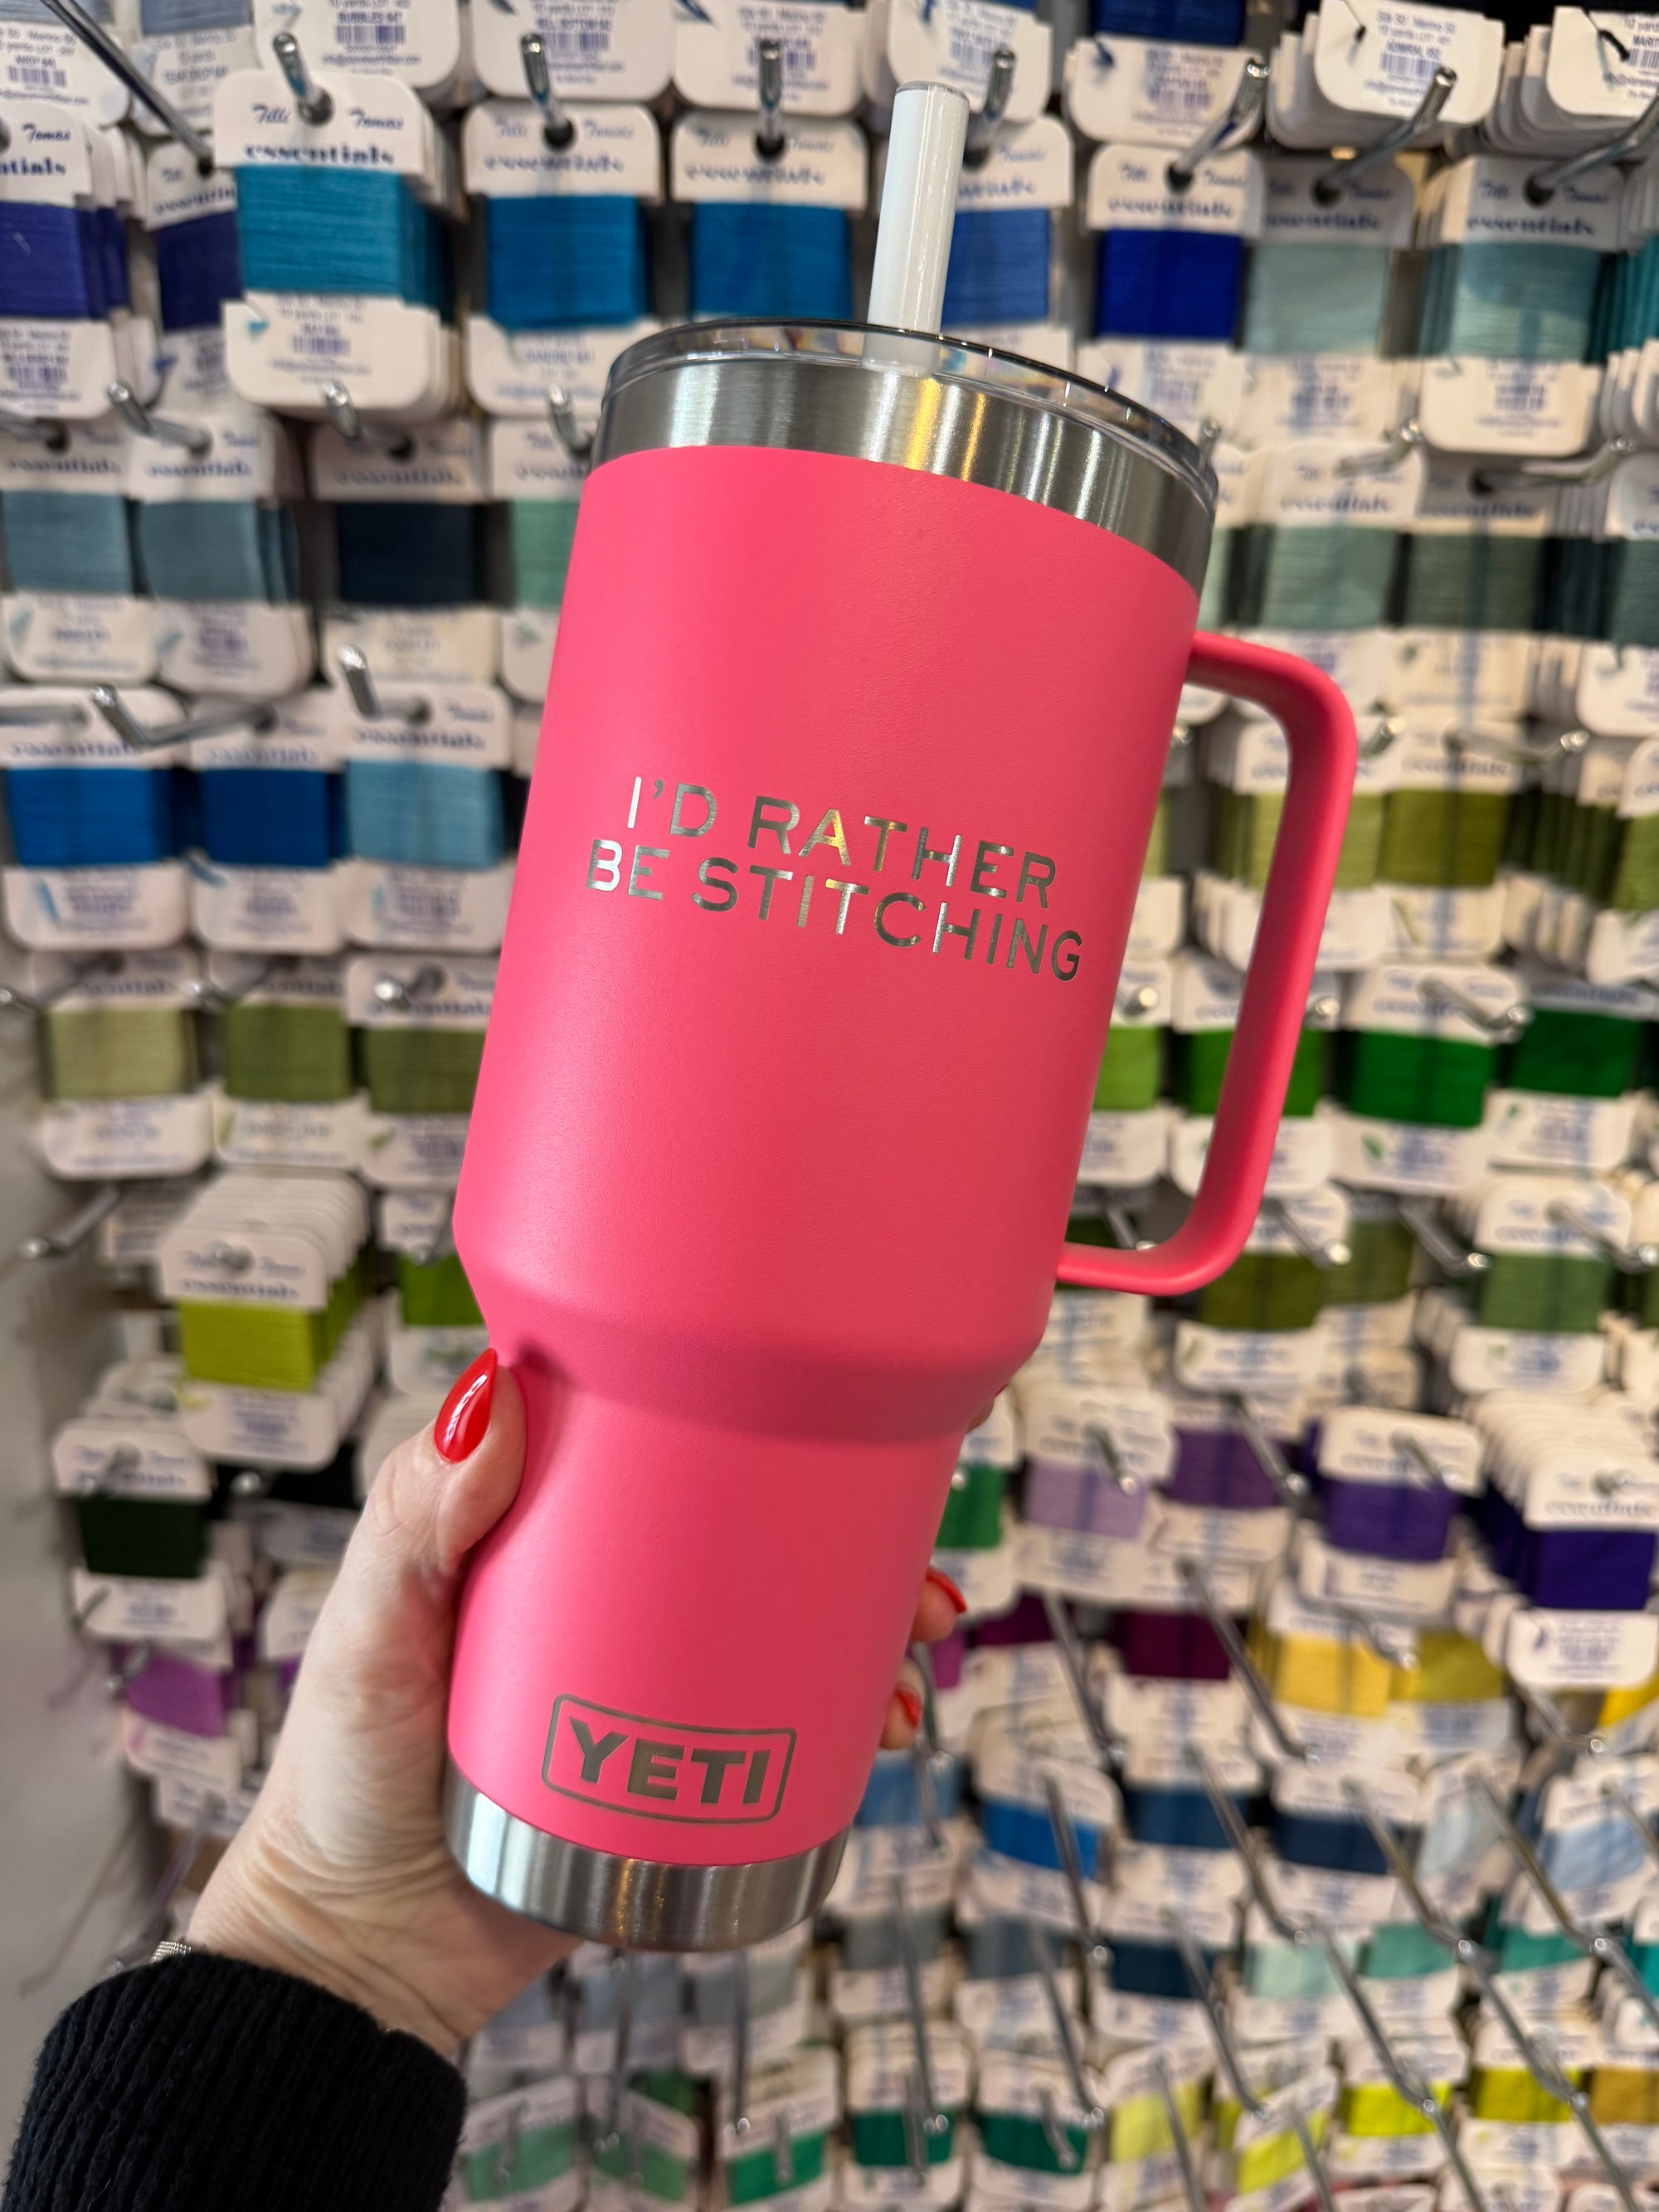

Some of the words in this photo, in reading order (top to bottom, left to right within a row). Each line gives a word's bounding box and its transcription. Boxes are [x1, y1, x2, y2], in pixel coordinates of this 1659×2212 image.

[244, 143, 396, 165] essentials
[627, 777, 717, 838] I'D
[748, 796, 1055, 909] RATHER
[586, 839, 669, 901] BE
[691, 858, 1082, 982] STITCHING
[570, 1717, 770, 1805] YETI
